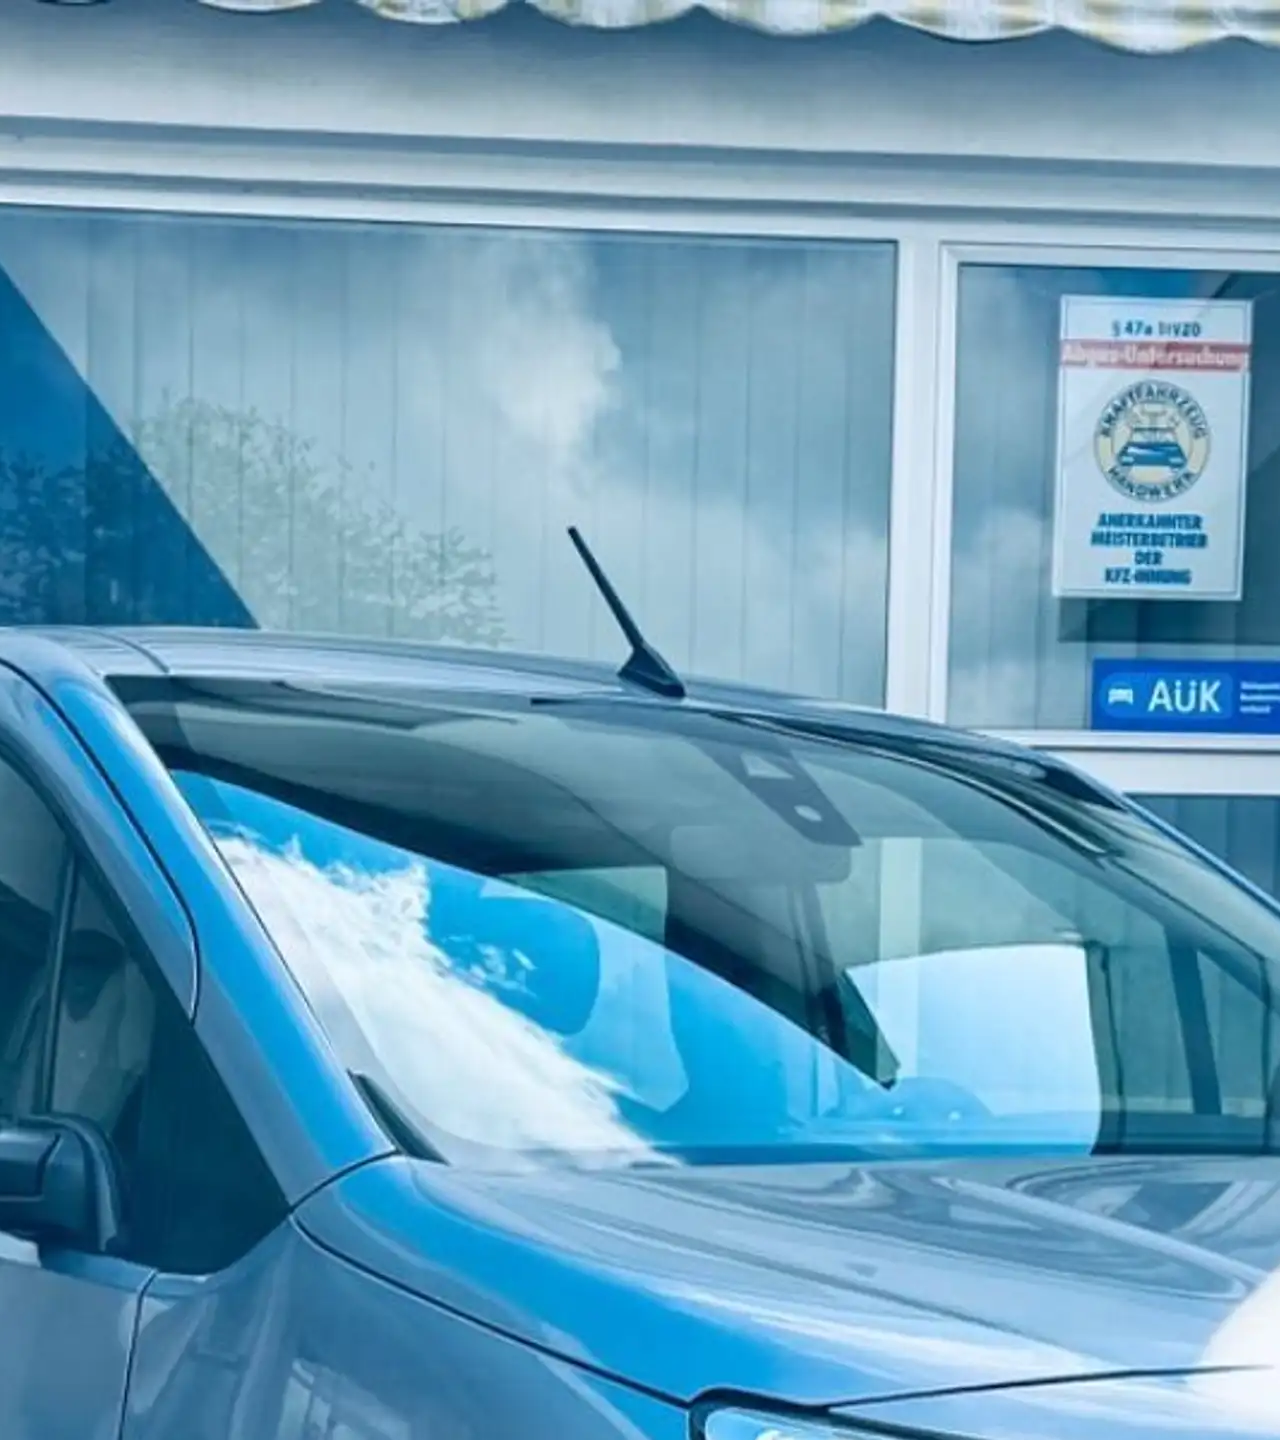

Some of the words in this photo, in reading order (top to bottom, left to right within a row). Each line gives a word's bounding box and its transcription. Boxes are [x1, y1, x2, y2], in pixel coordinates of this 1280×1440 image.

[1097, 512, 1203, 530] ANERKANNTER
[1090, 531, 1208, 549] MEISTERBETRIEB
[1133, 550, 1163, 566] DER
[1104, 567, 1192, 585] KFZ-INNUNG
[1147, 679, 1222, 714] AÜK
